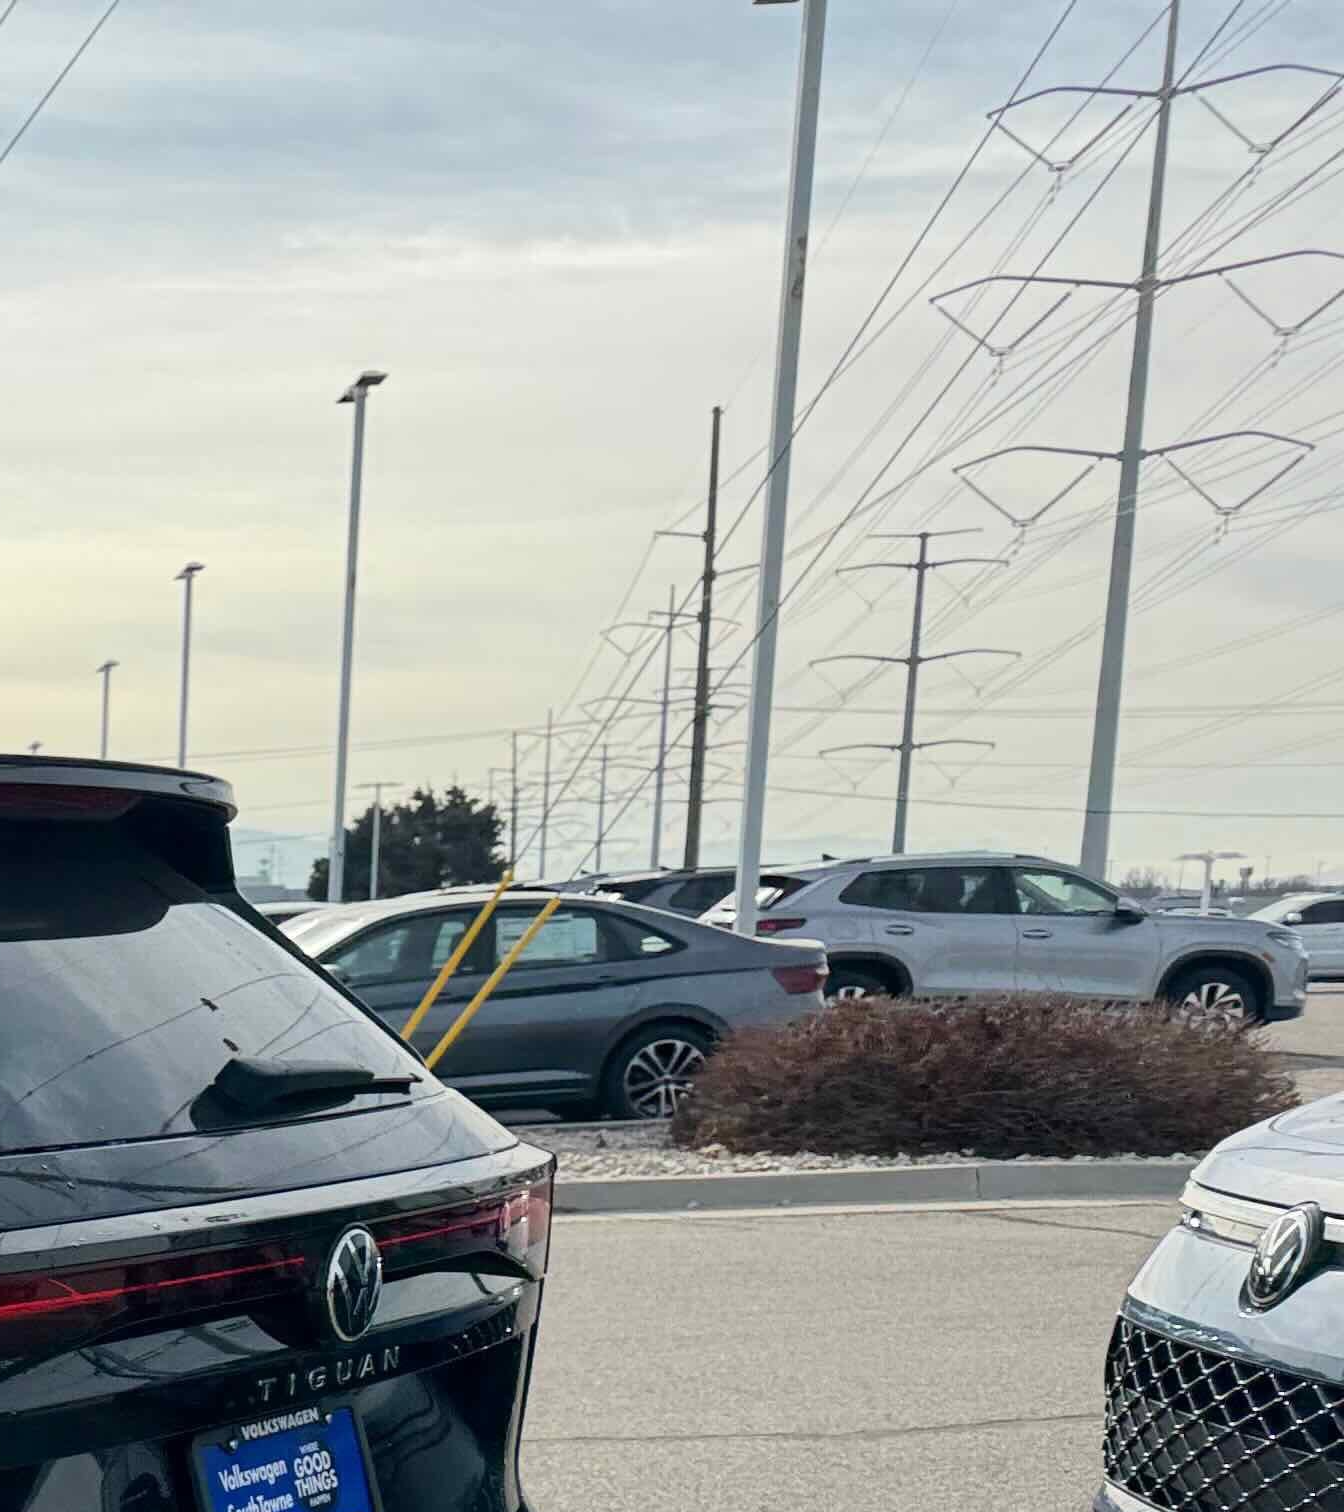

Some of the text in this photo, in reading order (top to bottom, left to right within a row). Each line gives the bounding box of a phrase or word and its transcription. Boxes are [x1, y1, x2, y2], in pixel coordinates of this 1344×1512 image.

[257, 1345, 402, 1402] TIGUAN
[241, 1407, 320, 1441] VOLKSWAGEN
[218, 1459, 288, 1493] Volkswagen
[293, 1450, 332, 1477] GOOD
[294, 1468, 339, 1499] THINGS
